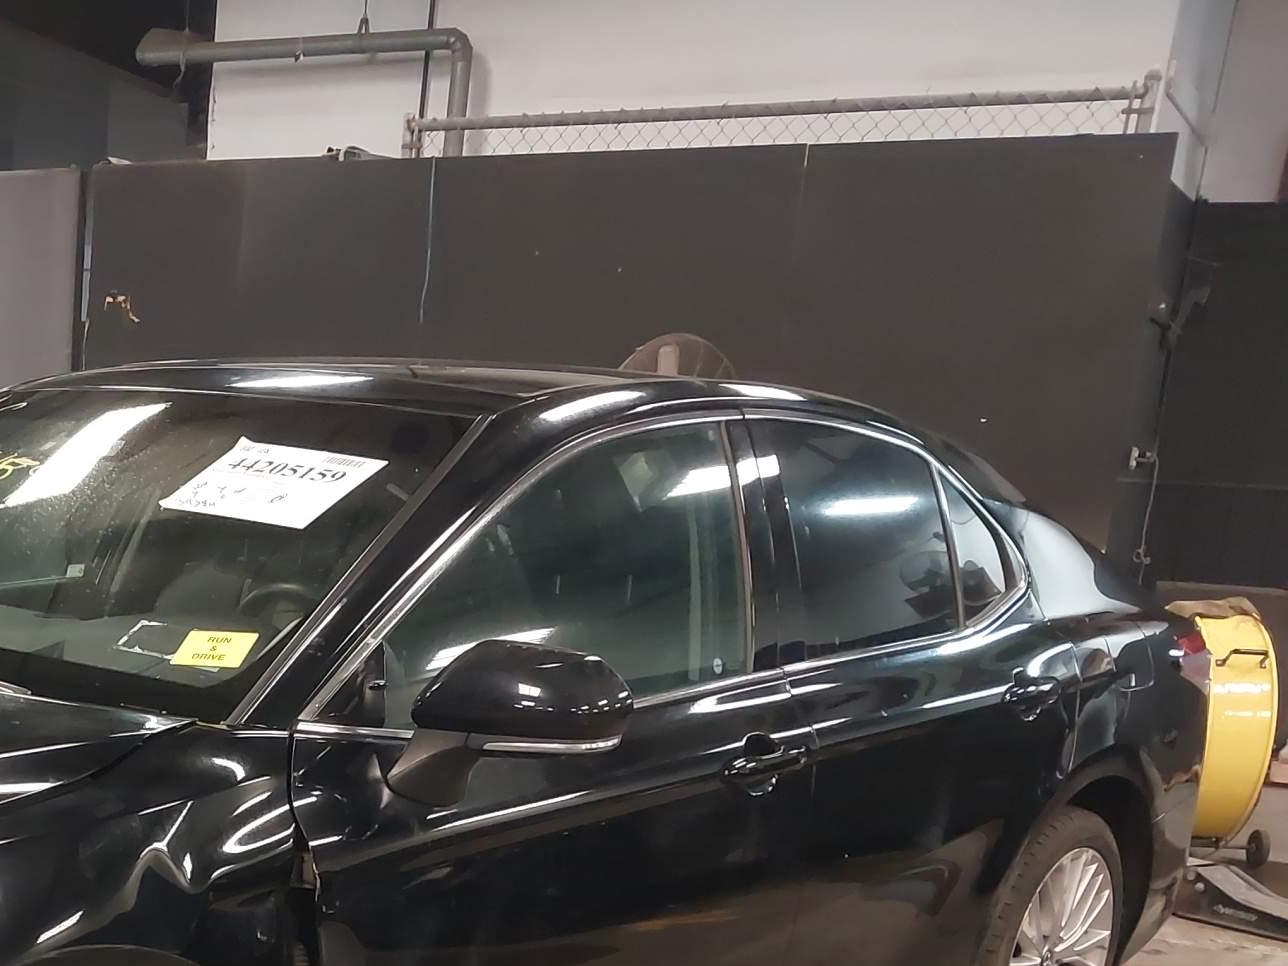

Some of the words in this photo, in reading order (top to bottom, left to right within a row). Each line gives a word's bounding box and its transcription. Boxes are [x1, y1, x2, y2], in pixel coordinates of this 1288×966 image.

[228, 457, 347, 484] 44205159
[207, 636, 233, 644] RUN
[191, 653, 227, 661] DRIVE
